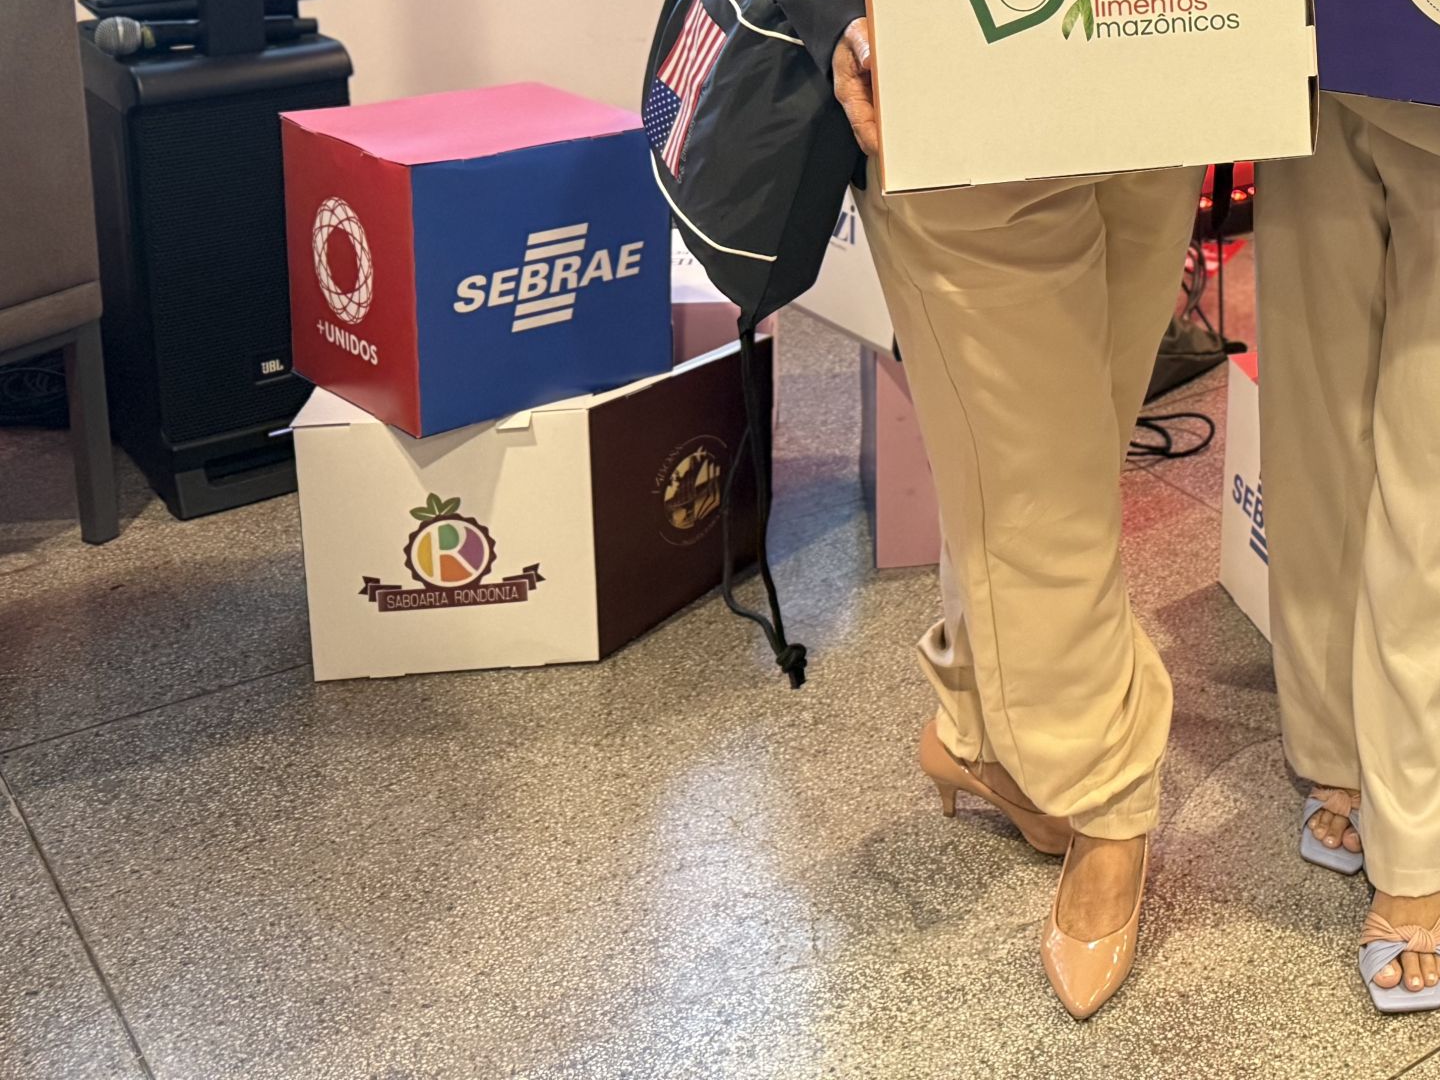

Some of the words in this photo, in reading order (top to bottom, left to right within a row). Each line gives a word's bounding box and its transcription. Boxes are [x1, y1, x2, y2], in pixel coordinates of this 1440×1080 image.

[453, 241, 645, 314] SEBRAE
[261, 359, 285, 375] JBL
[316, 321, 379, 367] +UNIDOS
[1232, 473, 1264, 530] SEB
[385, 591, 449, 609] SABOARIA
[454, 583, 520, 604] RONDÔNIA
